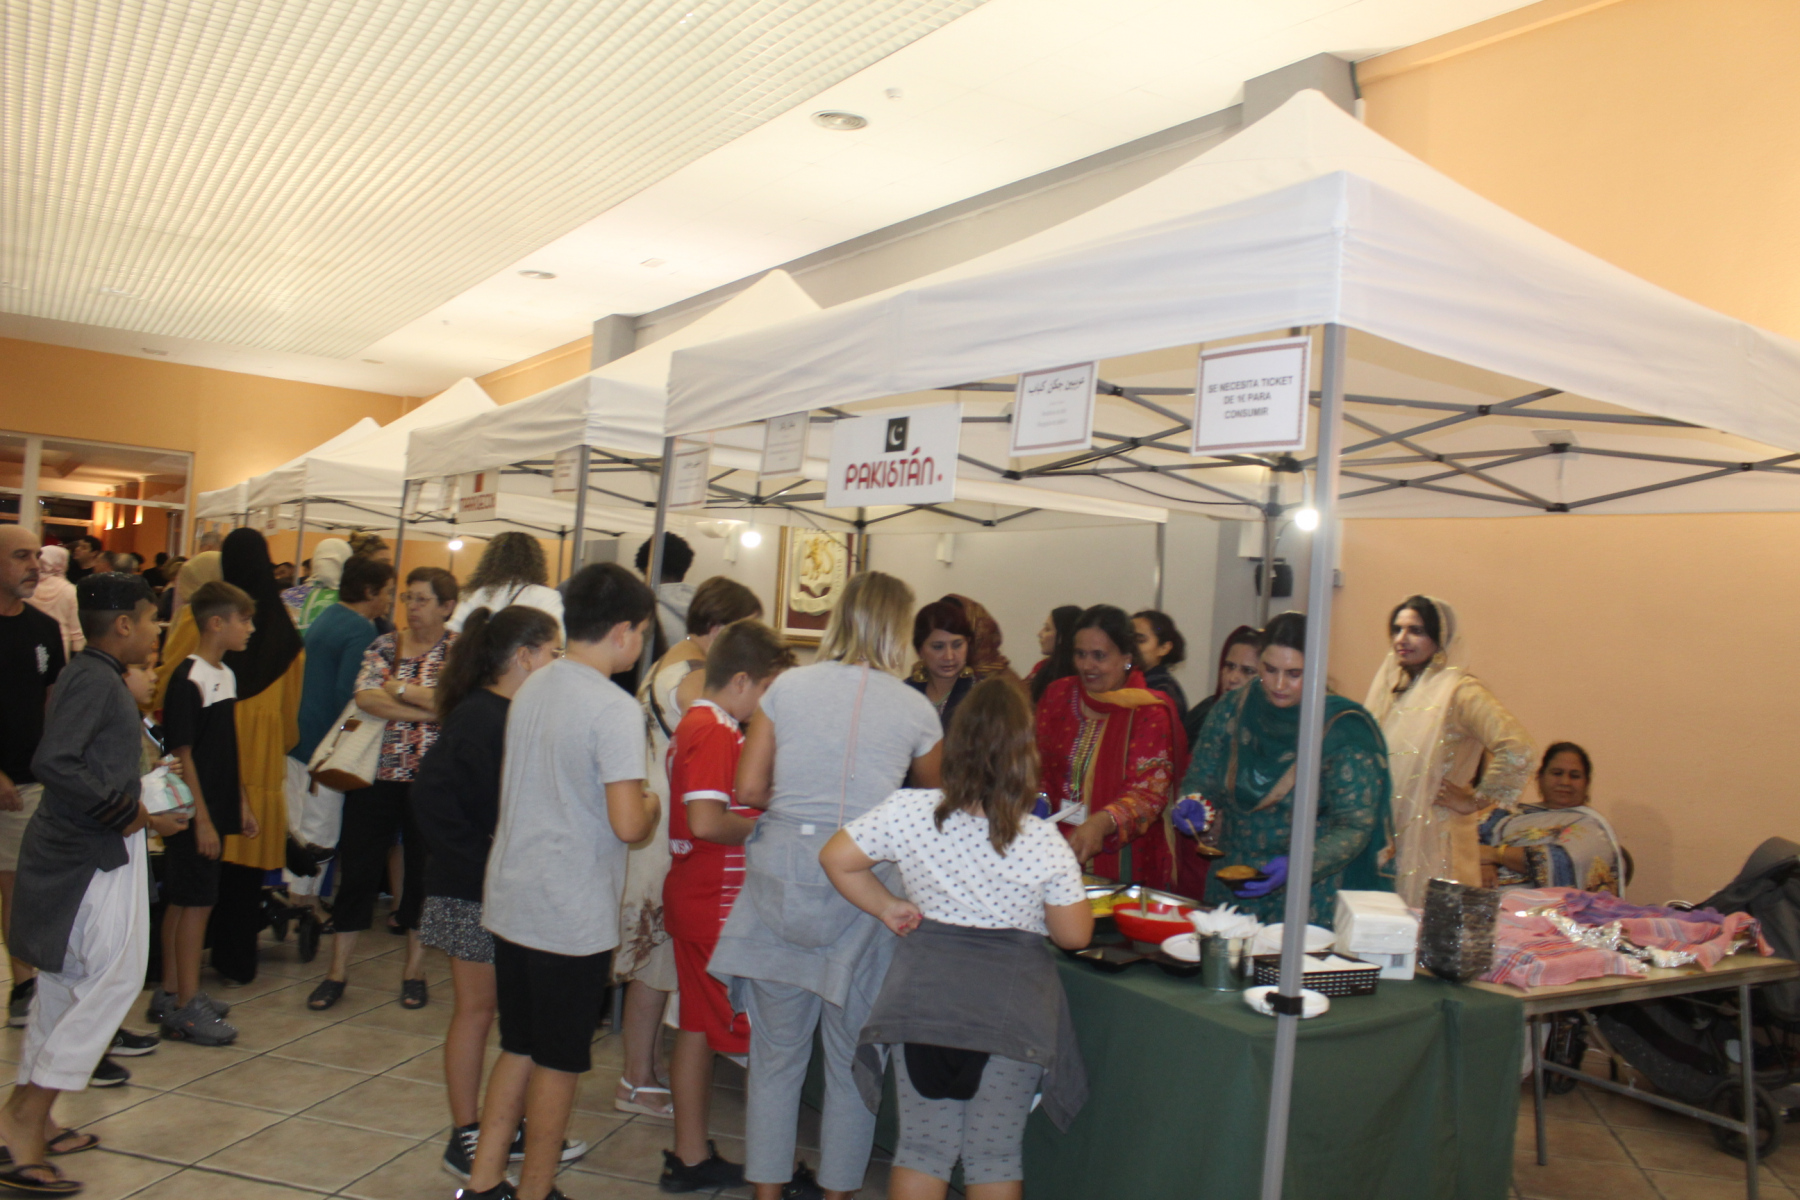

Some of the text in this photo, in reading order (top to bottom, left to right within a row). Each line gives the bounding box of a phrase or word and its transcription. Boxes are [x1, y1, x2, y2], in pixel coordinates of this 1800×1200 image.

[1208, 375, 1294, 393] SE NECESITA TICKET
[1224, 395, 1235, 405] DE
[1247, 391, 1272, 402] PARA
[1224, 406, 1269, 419] CONSUMIR
